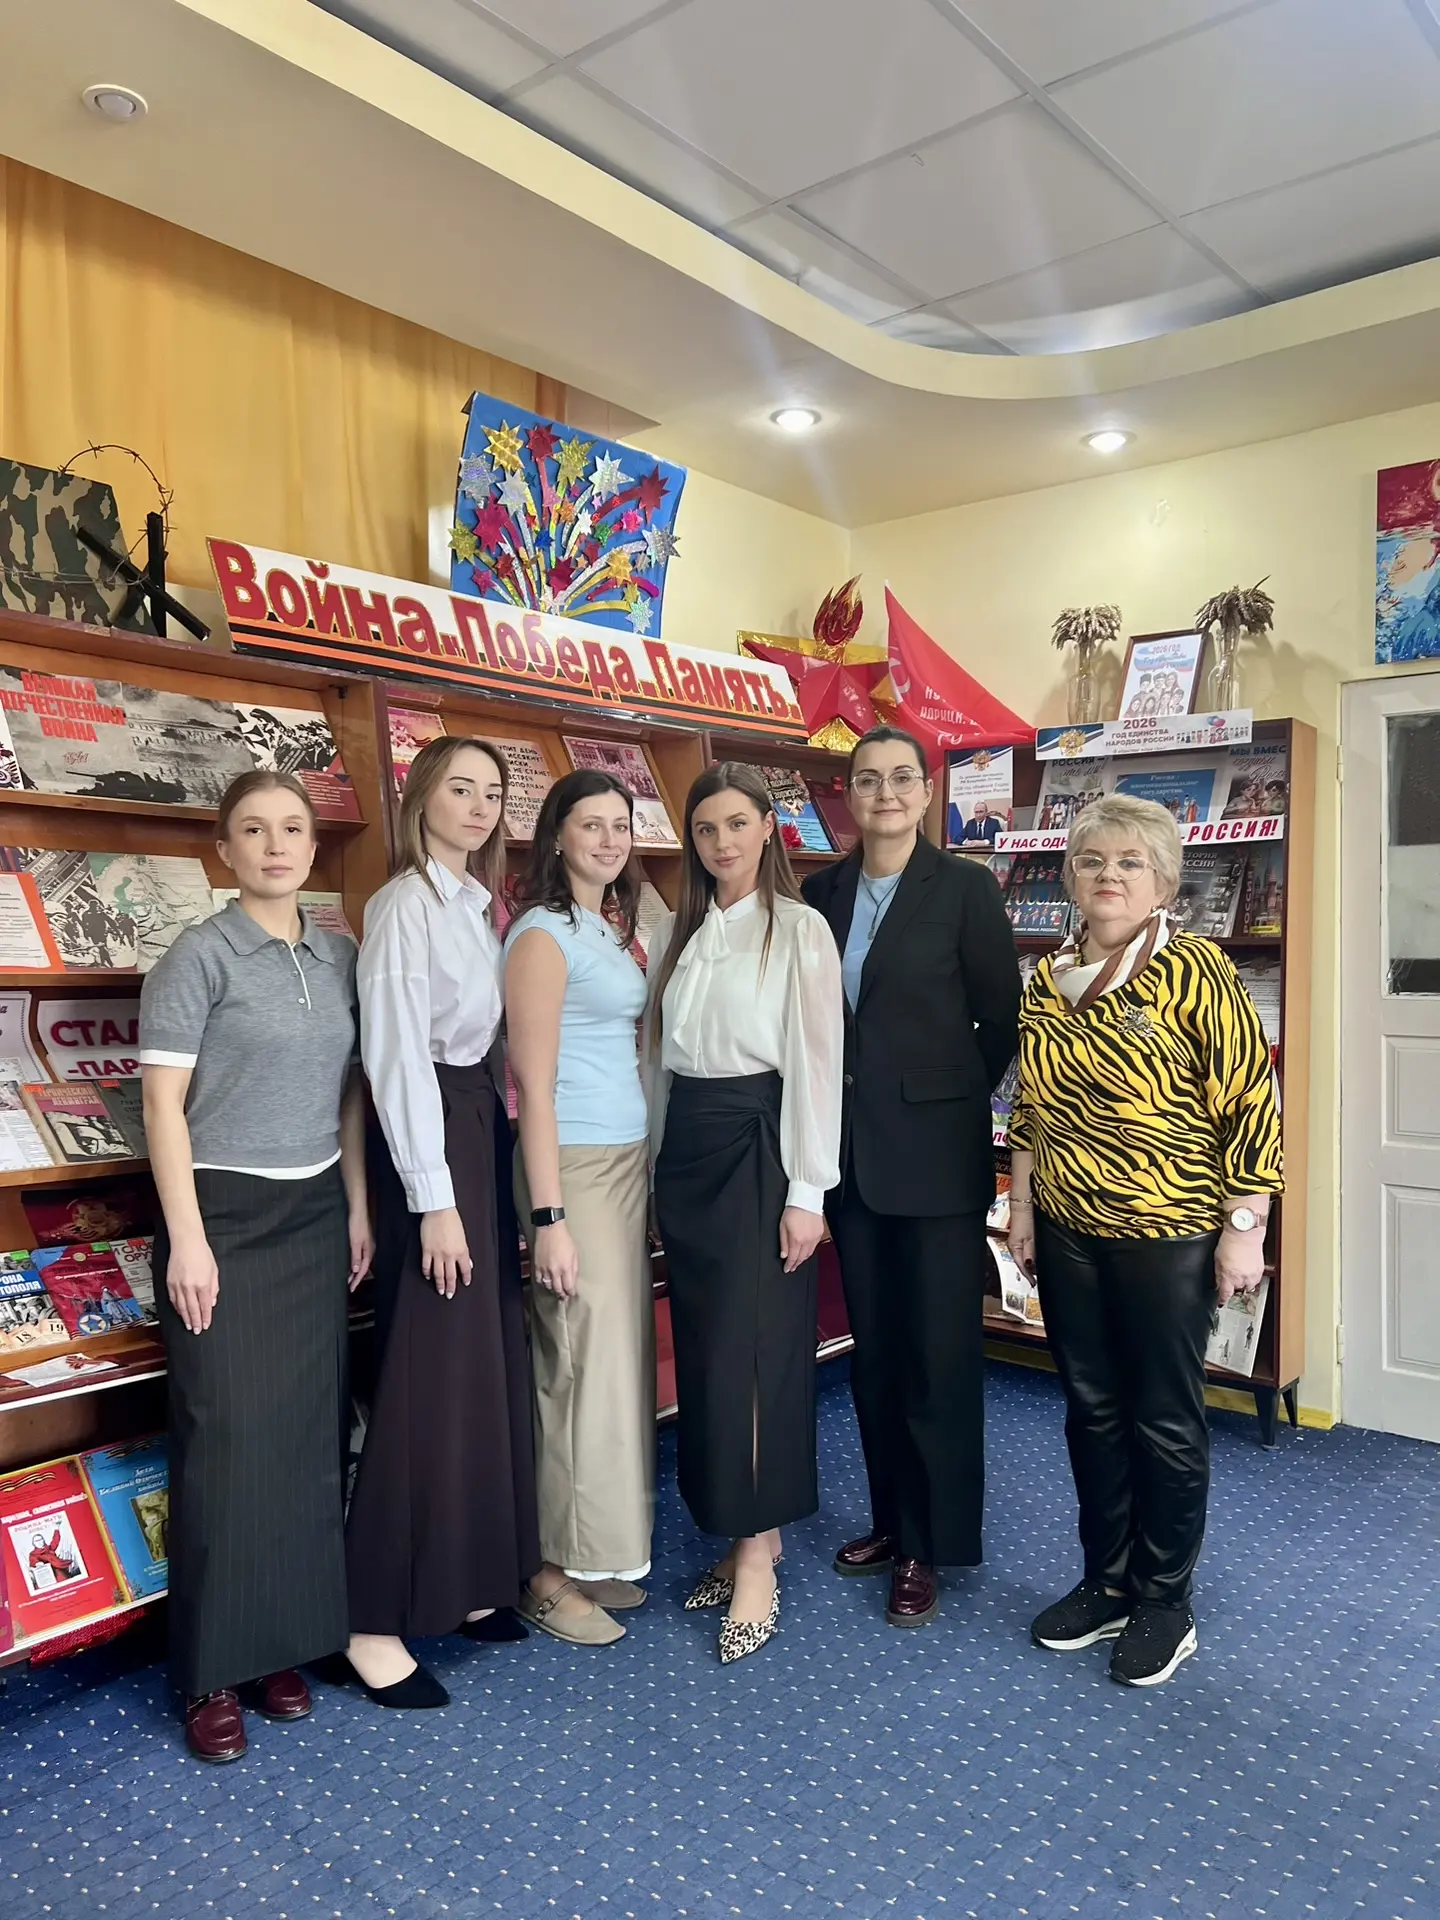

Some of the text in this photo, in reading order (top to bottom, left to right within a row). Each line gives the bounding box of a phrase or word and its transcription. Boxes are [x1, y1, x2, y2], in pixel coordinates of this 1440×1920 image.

[20, 671, 97, 702] ВЕЛИКАЯ
[40, 716, 98, 742] ВОЙНА
[1123, 717, 1157, 730] 2026
[1111, 729, 1169, 740] ГОД ЕДИНСТВА
[1105, 735, 1174, 747] НАРОДОВ РОССИИ
[1230, 747, 1251, 756] МЫ
[1051, 757, 1095, 768] РОССИЯ
[998, 838, 1009, 849] У
[1011, 838, 1037, 849] НАС
[1243, 870, 1254, 934] РОССИЯ
[51, 1095, 101, 1106] ЛЕНИНГРАД
[49, 1323, 64, 1332] 19
[16, 1331, 32, 1343] 18
